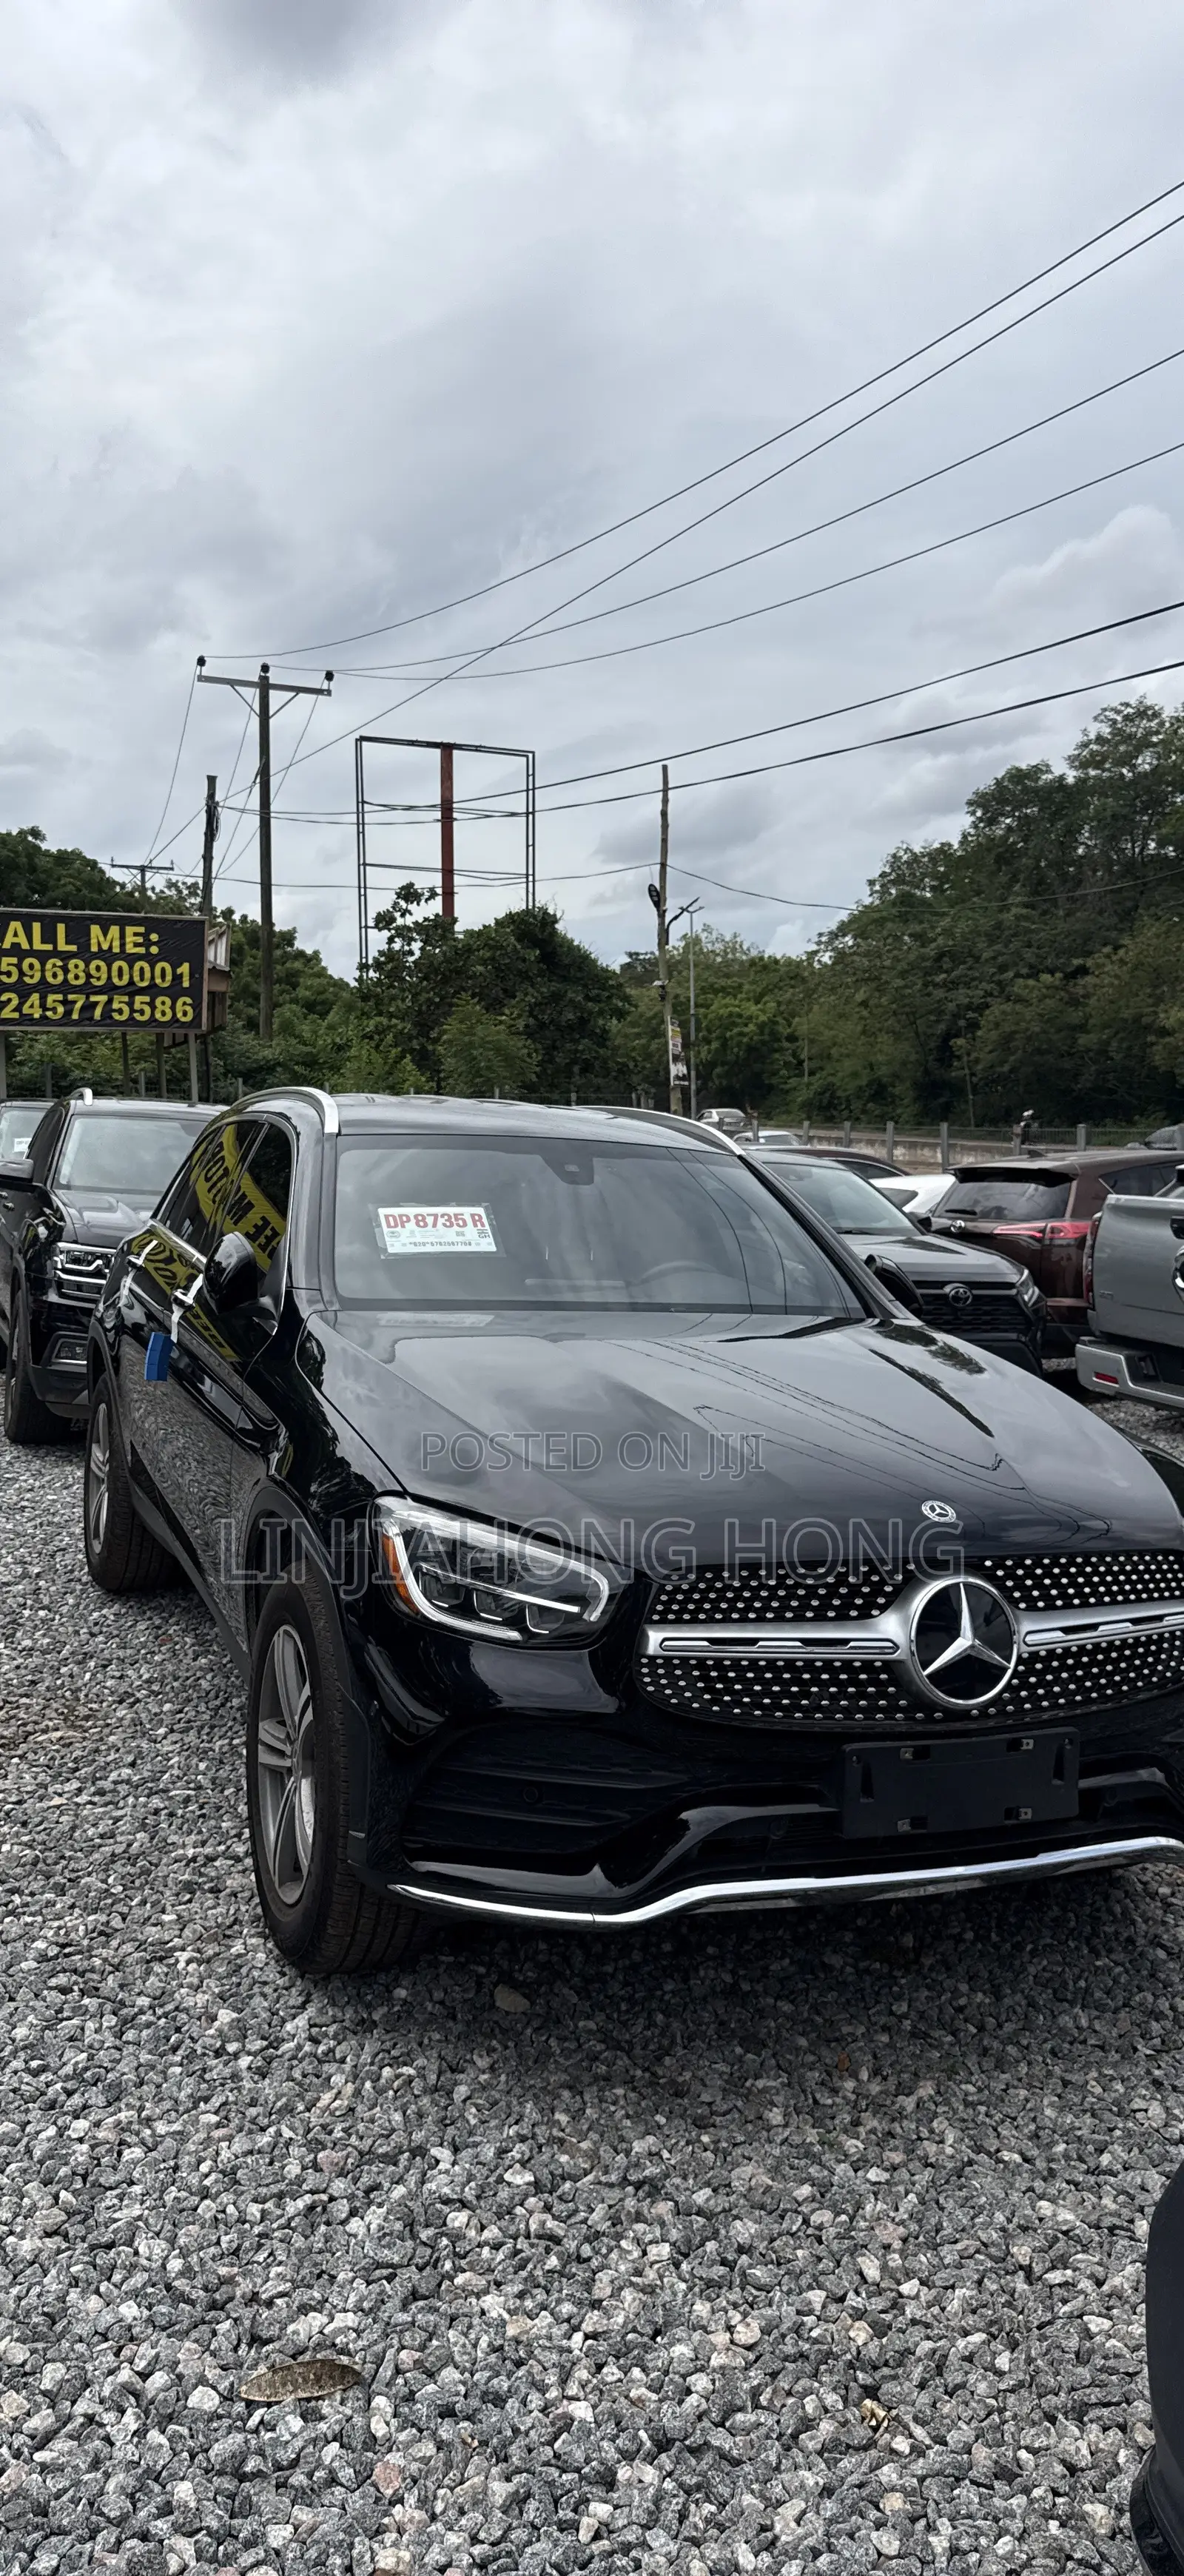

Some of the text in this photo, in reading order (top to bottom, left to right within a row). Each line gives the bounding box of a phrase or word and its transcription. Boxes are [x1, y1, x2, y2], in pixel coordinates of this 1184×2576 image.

[0, 921, 160, 955] ALL ME:
[0, 956, 191, 988] 596890001
[0, 992, 194, 1022] 245775586
[383, 1212, 486, 1229] DP 8735 R
